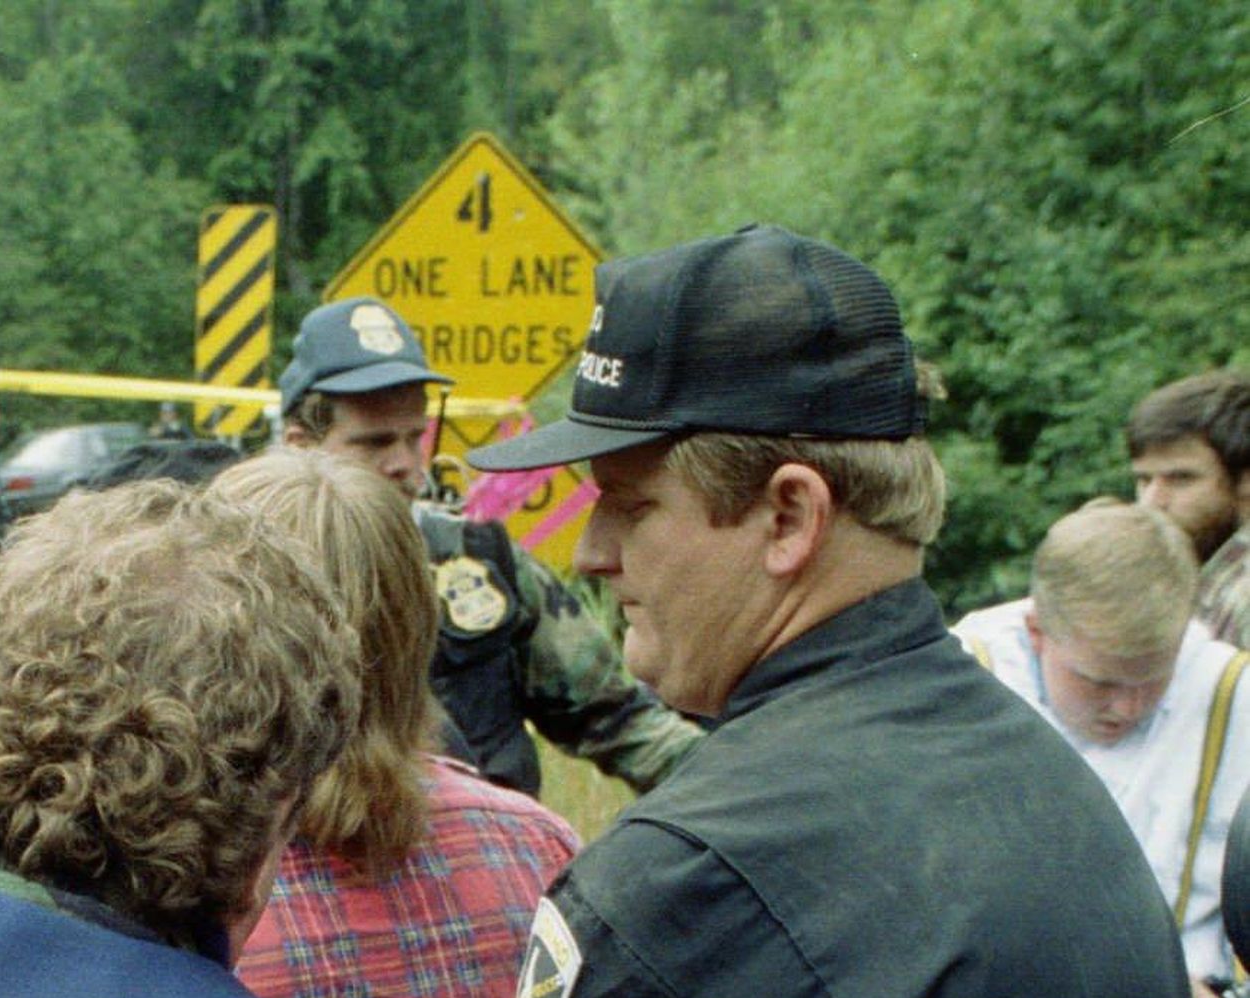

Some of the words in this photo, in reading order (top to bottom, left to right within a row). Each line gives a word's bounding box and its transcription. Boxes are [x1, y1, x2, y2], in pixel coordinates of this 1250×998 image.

[456, 174, 492, 232] 4
[373, 257, 448, 298] ONE
[480, 254, 581, 297] LANE
